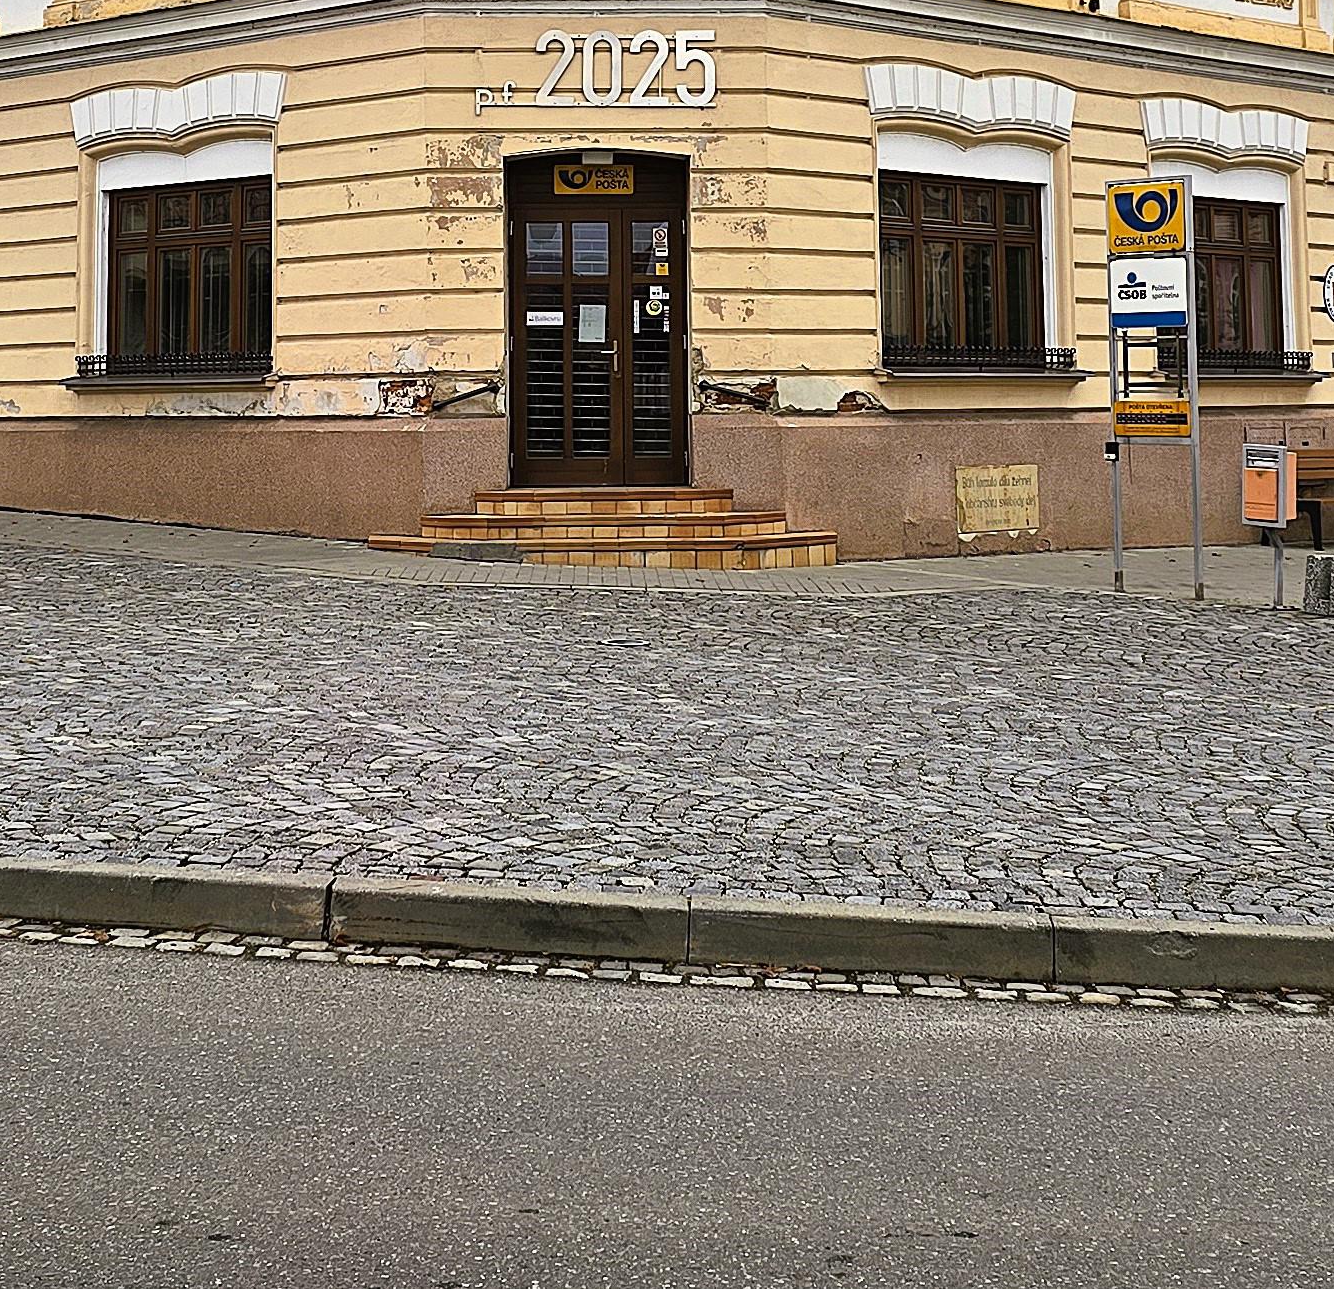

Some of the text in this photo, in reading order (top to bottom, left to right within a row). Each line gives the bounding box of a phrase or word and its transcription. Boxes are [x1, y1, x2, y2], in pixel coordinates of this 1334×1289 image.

[535, 29, 717, 106] 2025
[594, 167, 629, 179] ČESKÁ
[595, 179, 629, 190] POŠTA
[1114, 232, 1179, 247] ČESKÁ POŠTA
[1117, 289, 1147, 300] ČSOB
